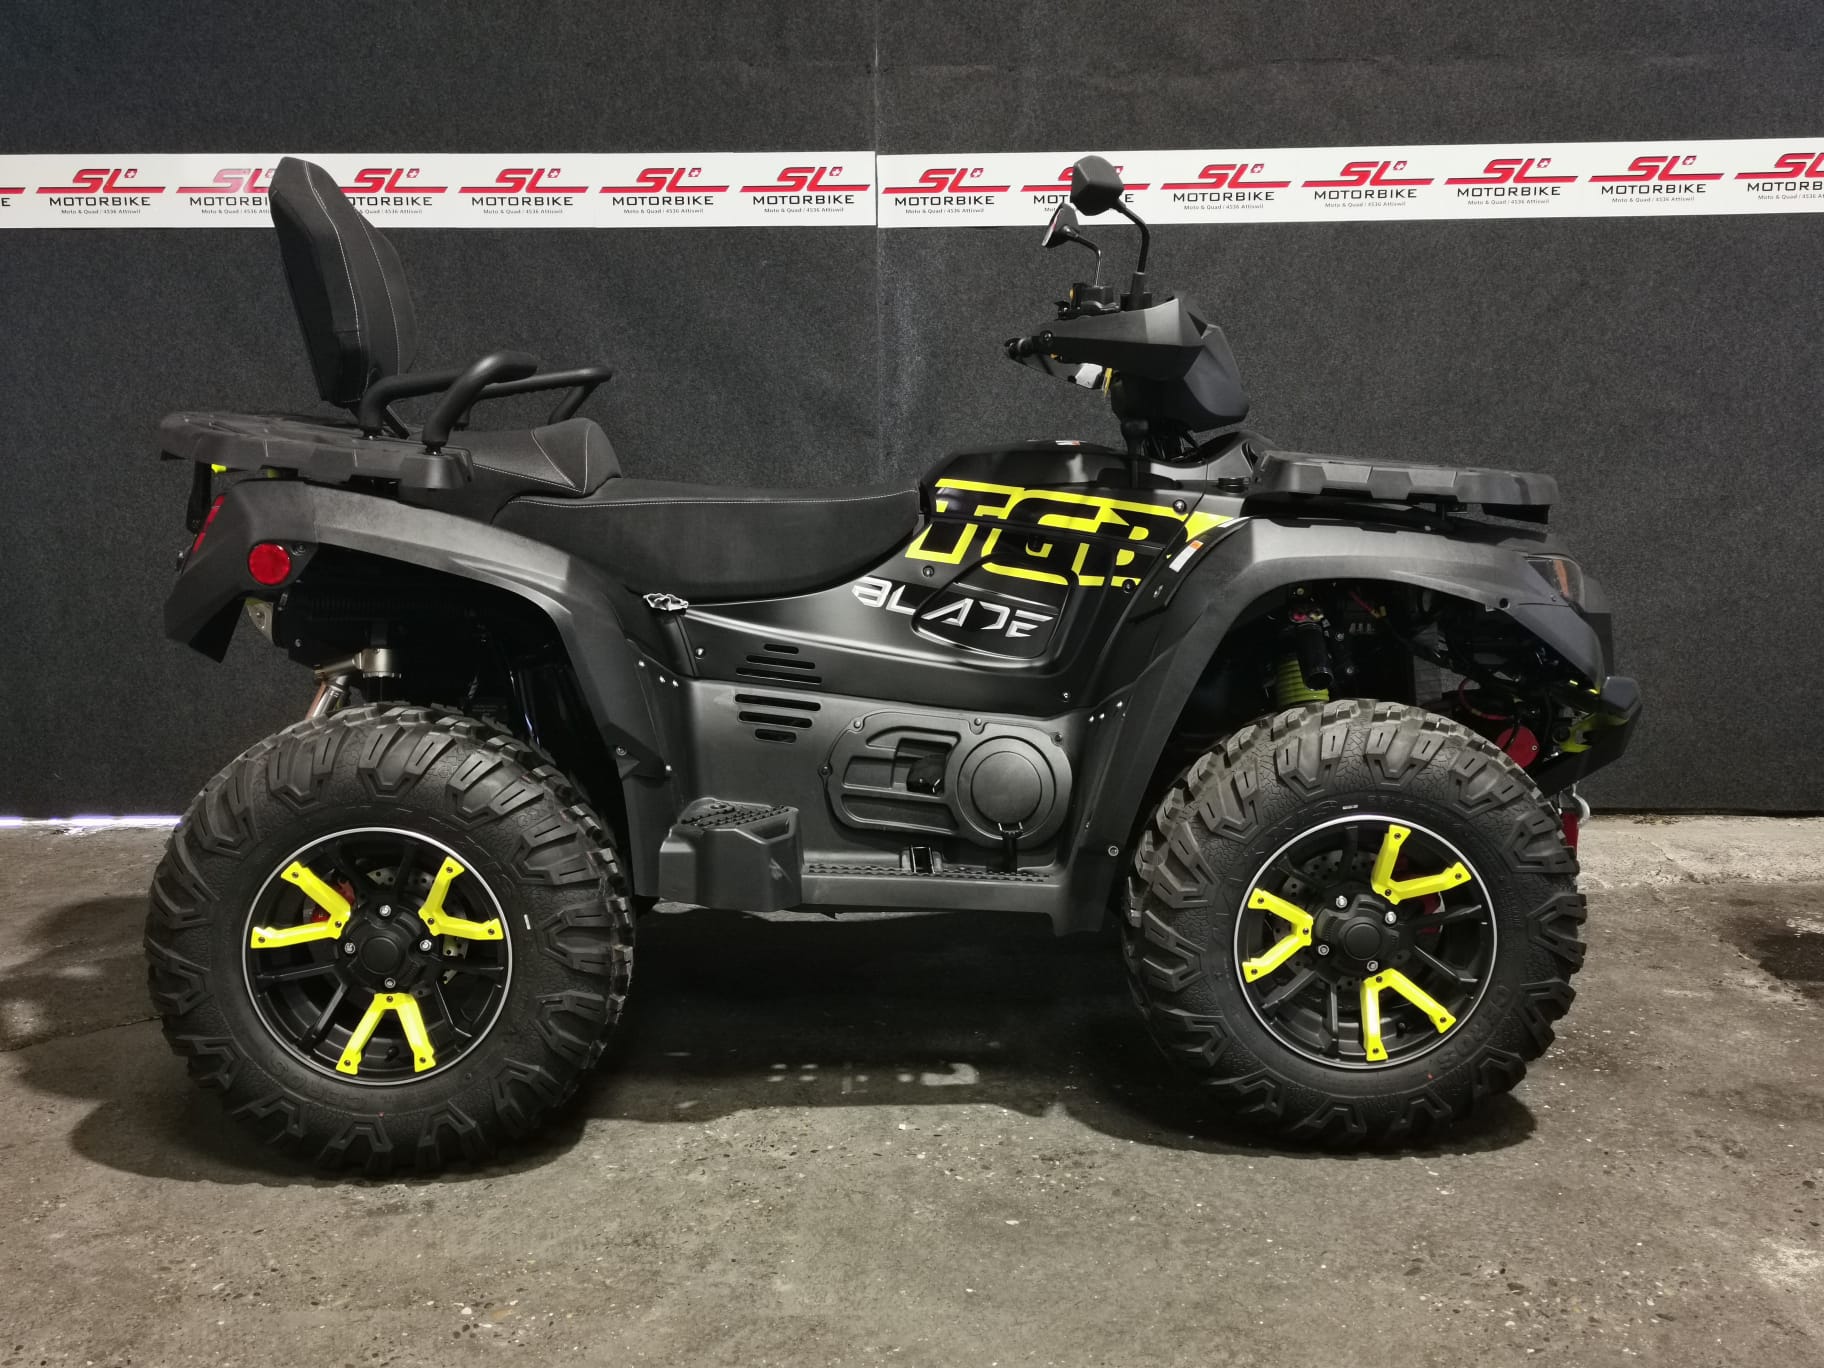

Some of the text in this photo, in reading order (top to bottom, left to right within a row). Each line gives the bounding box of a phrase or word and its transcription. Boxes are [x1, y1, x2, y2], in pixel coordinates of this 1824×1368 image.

[1602, 184, 1706, 194] MOTORBIKE
[1747, 181, 1822, 192] MOTORB
[1174, 192, 1275, 202] MOTORBIKE
[1315, 189, 1417, 200] MOTORBIKE
[1458, 187, 1560, 197] MOTORBIKE
[50, 197, 151, 206] MOTORBIKE
[190, 197, 267, 206] MOTORBI
[348, 196, 433, 206] OTORBIKE
[472, 197, 573, 206] MOTORBIKE
[613, 196, 713, 205] MOTORBIKE
[753, 195, 855, 205] MOTORBIKE
[895, 196, 995, 206] MOTORBIKE
[851, 576, 1055, 638] BLADE
